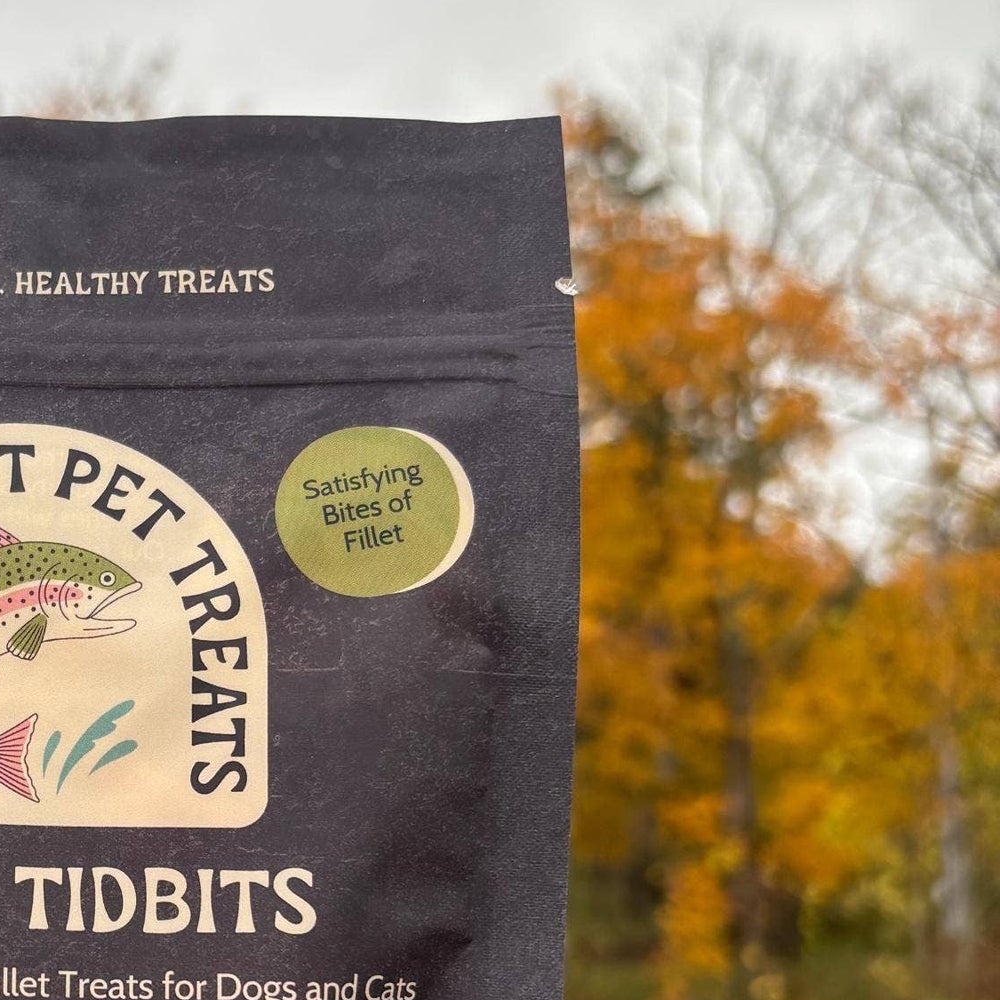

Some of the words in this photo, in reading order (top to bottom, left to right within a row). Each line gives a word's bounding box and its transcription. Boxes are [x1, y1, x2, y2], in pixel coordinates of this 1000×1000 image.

[14, 271, 149, 295] HEALTHY
[158, 268, 276, 294] TREATS
[302, 464, 424, 500] Satisfying
[322, 502, 382, 526] Bites
[388, 489, 413, 513] of
[343, 524, 405, 553] Fillet
[54, 448, 186, 541] PET
[168, 539, 249, 796] TREATS
[13, 867, 317, 936] TIDBITS
[58, 971, 153, 1000] Treats
